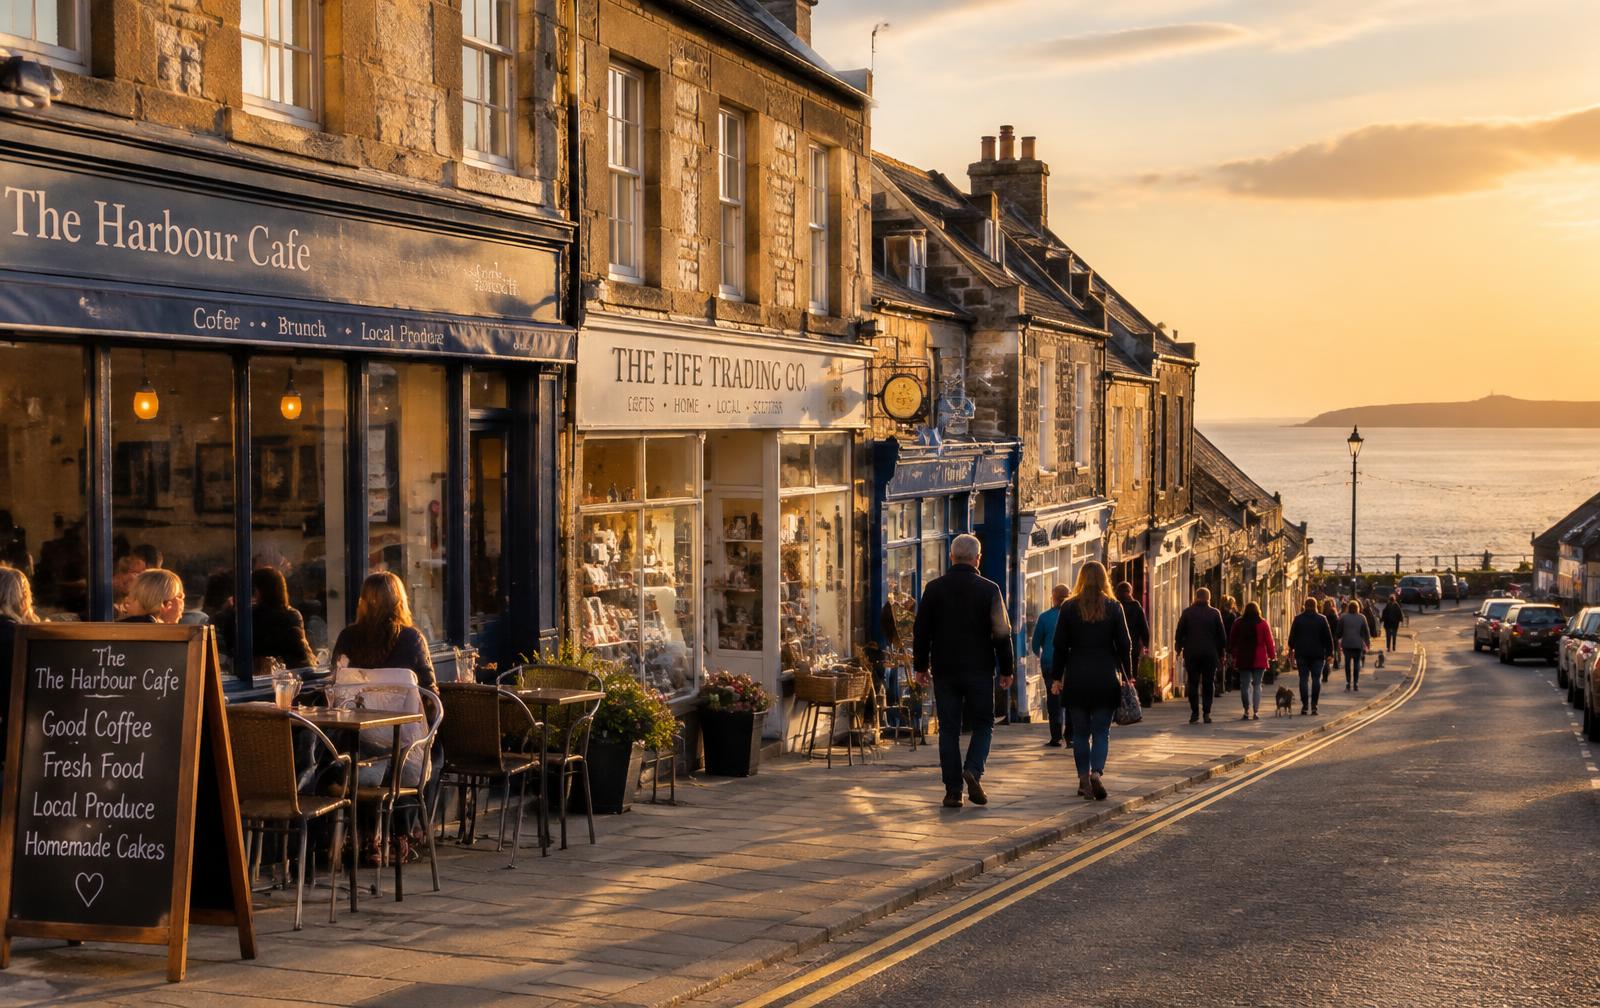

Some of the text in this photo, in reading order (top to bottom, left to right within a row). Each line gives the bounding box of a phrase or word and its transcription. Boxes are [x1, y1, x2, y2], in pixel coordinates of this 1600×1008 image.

[4, 185, 311, 272] The Harbour Cafe
[278, 316, 327, 338] Brunch
[361, 322, 395, 342] Local
[611, 346, 656, 385] THE
[662, 350, 704, 387] FIFE
[708, 355, 782, 392] TRADING
[674, 398, 700, 414] HOME
[92, 644, 126, 667] The
[35, 666, 180, 698] The Harbour Cafe
[42, 707, 153, 745] Good Coffee
[43, 751, 145, 780] Fresh Food
[33, 791, 156, 820] Local Produce
[24, 830, 166, 861] Homemade Cakes
